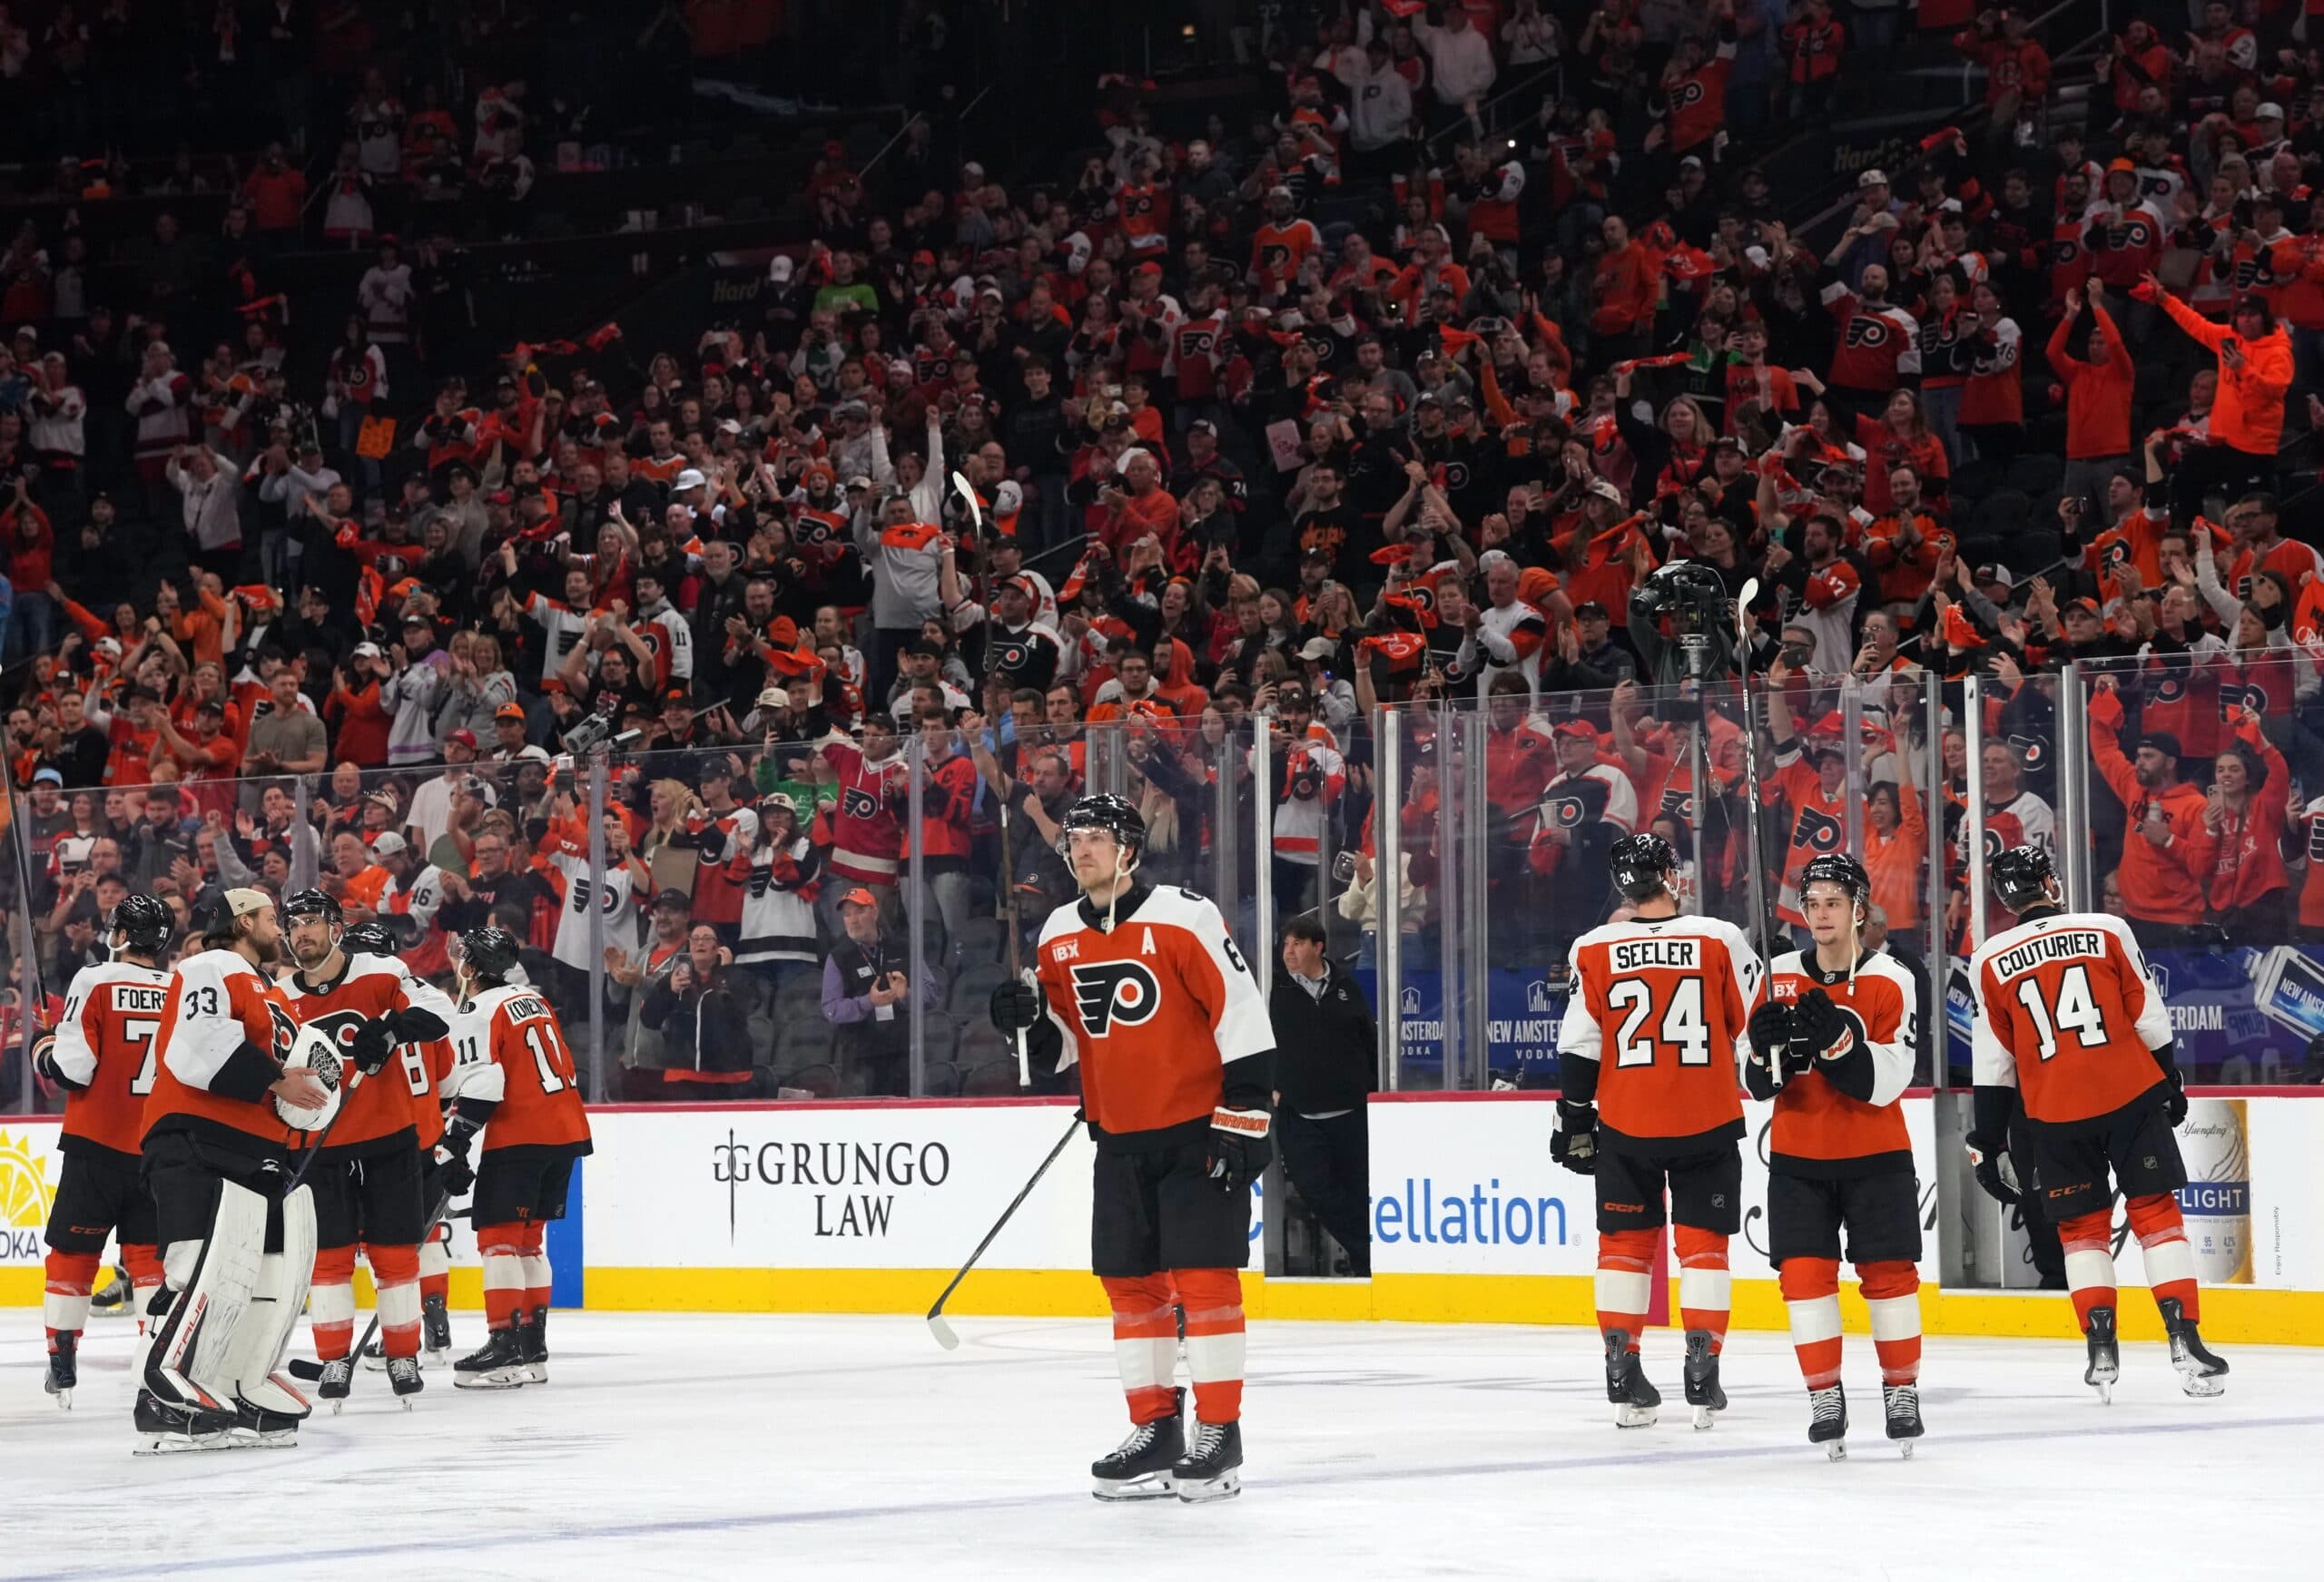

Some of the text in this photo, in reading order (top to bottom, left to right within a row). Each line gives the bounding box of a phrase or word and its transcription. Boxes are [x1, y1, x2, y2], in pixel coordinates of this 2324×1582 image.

[713, 278, 761, 304] Hard
[675, 632, 687, 646] 11
[1025, 634, 1039, 650] A
[1620, 870, 1635, 885] 24
[2004, 880, 2017, 894] 14
[157, 926, 169, 938] 71
[1141, 926, 1157, 955] A
[1051, 943, 1079, 963] IBX
[1616, 942, 1693, 969] SEELER
[1997, 932, 2100, 978] COUTURIER
[1773, 983, 1798, 997] BX
[2280, 977, 2303, 1000] NEW
[185, 986, 219, 1020] 33
[2015, 963, 2111, 1063] 14
[1486, 1021, 1512, 1044] NEW
[1606, 976, 1711, 1069] 24
[458, 1036, 479, 1066] 11
[1515, 1049, 1561, 1061] VODK
[2180, 1120, 2228, 1138] Yuengling
[757, 1141, 950, 1186] GRUNGO
[2048, 1182, 2093, 1199] CCM
[2172, 1188, 2243, 1209] FLIGHT
[814, 1194, 894, 1237] LAW
[1369, 1178, 1567, 1246] ellation
[1603, 1202, 1646, 1214] CCM
[172, 1292, 209, 1361] TRUE
